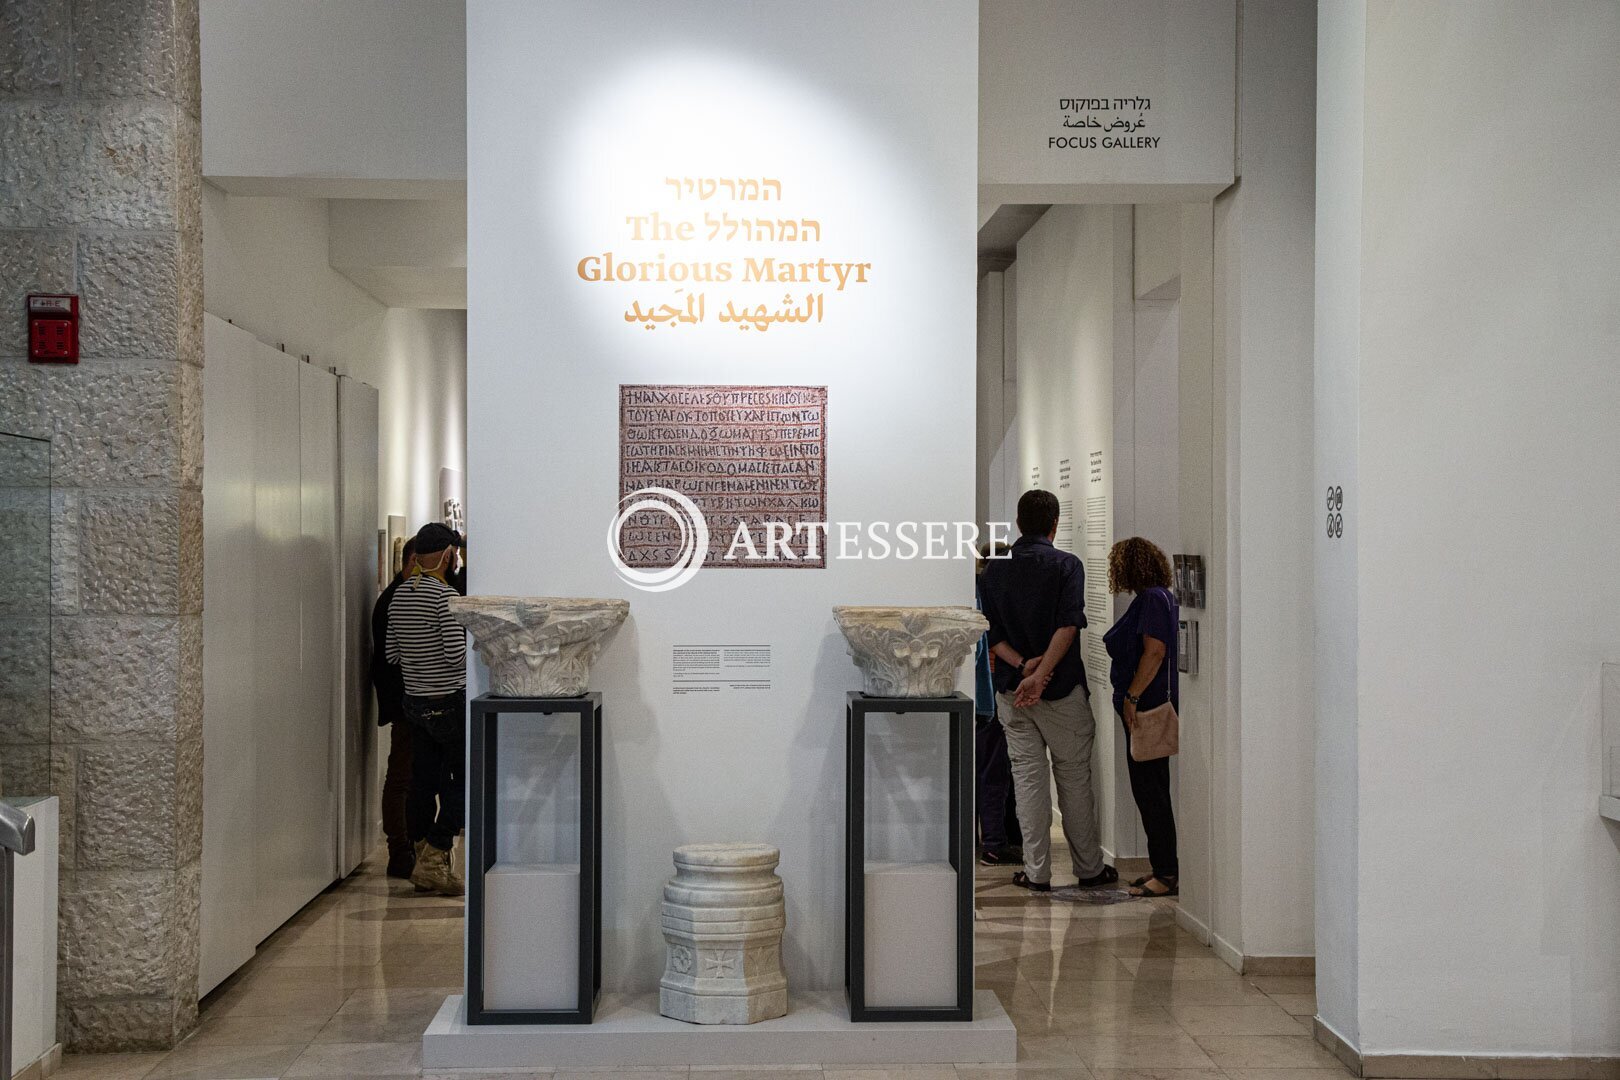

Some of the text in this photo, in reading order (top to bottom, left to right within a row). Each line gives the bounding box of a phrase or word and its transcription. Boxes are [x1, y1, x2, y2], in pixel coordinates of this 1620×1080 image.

[1059, 96, 1151, 113] גלריה בפוקוס
[1063, 115, 1102, 128] خاصة
[1048, 136, 1161, 149] FOCUS GALLERY
[665, 176, 782, 201] המרטיר
[625, 211, 695, 241] The
[704, 212, 821, 242] המהולל
[577, 252, 872, 291] Glorious Martyr
[718, 292, 824, 332] الشهيد
